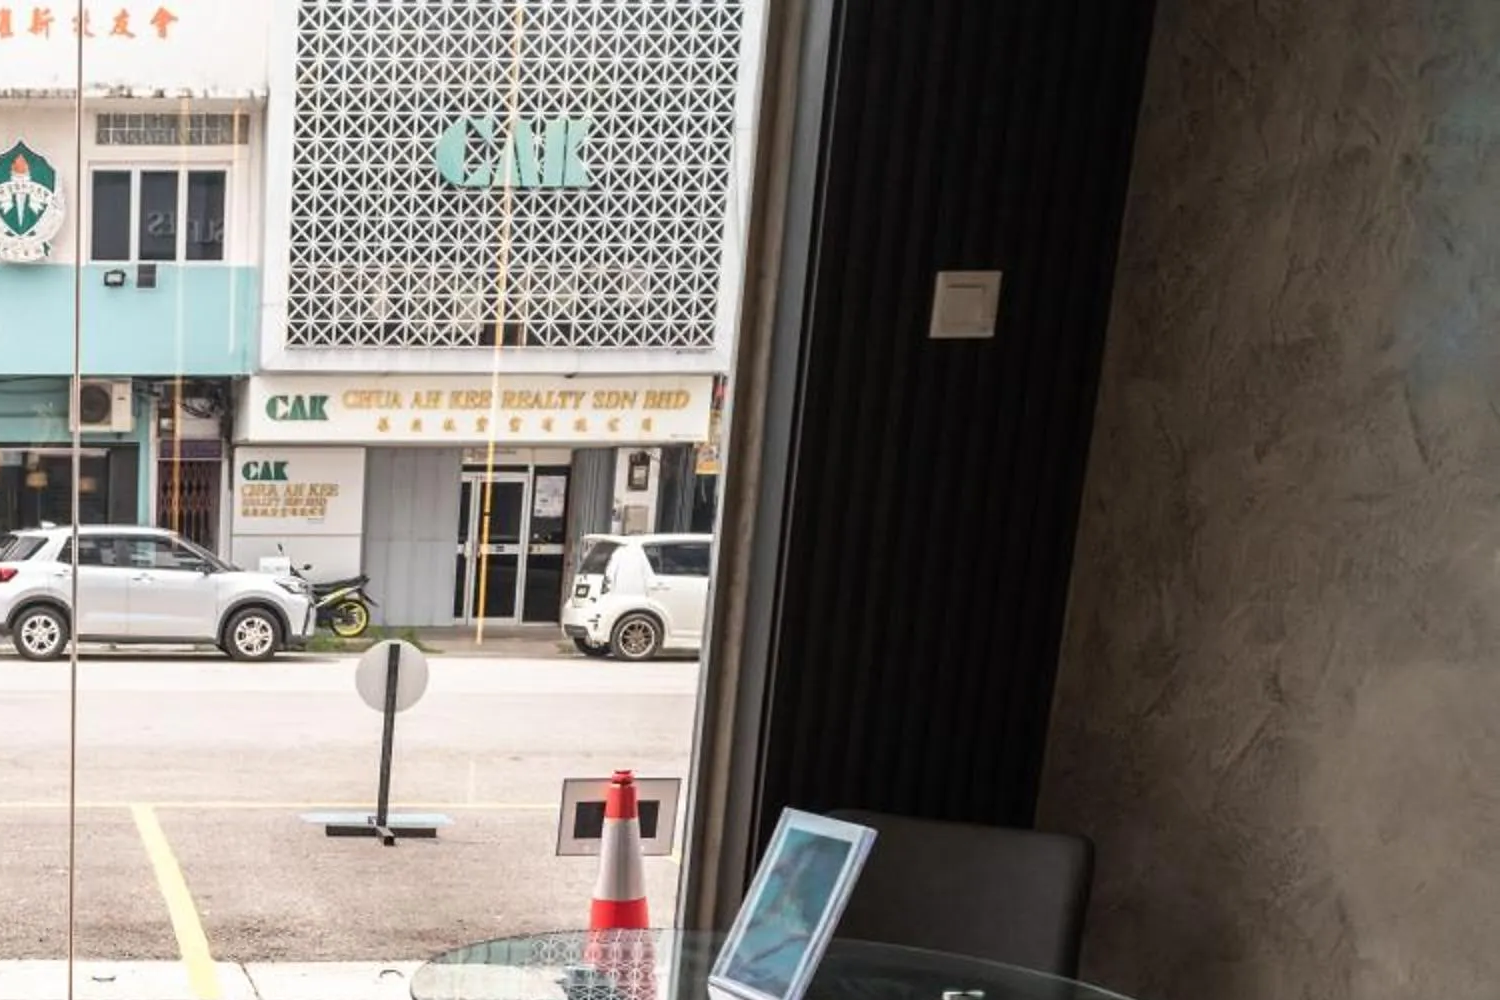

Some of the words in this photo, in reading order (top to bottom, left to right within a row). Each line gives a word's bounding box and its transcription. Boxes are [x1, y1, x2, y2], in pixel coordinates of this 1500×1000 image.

[435, 117, 592, 188] CAK
[265, 395, 330, 421] CAK
[342, 390, 401, 409] CHUA
[411, 390, 443, 409] AH
[501, 389, 585, 410] REALTY
[592, 389, 637, 410] SDN
[642, 389, 691, 410] BHD
[242, 461, 289, 481] CAK
